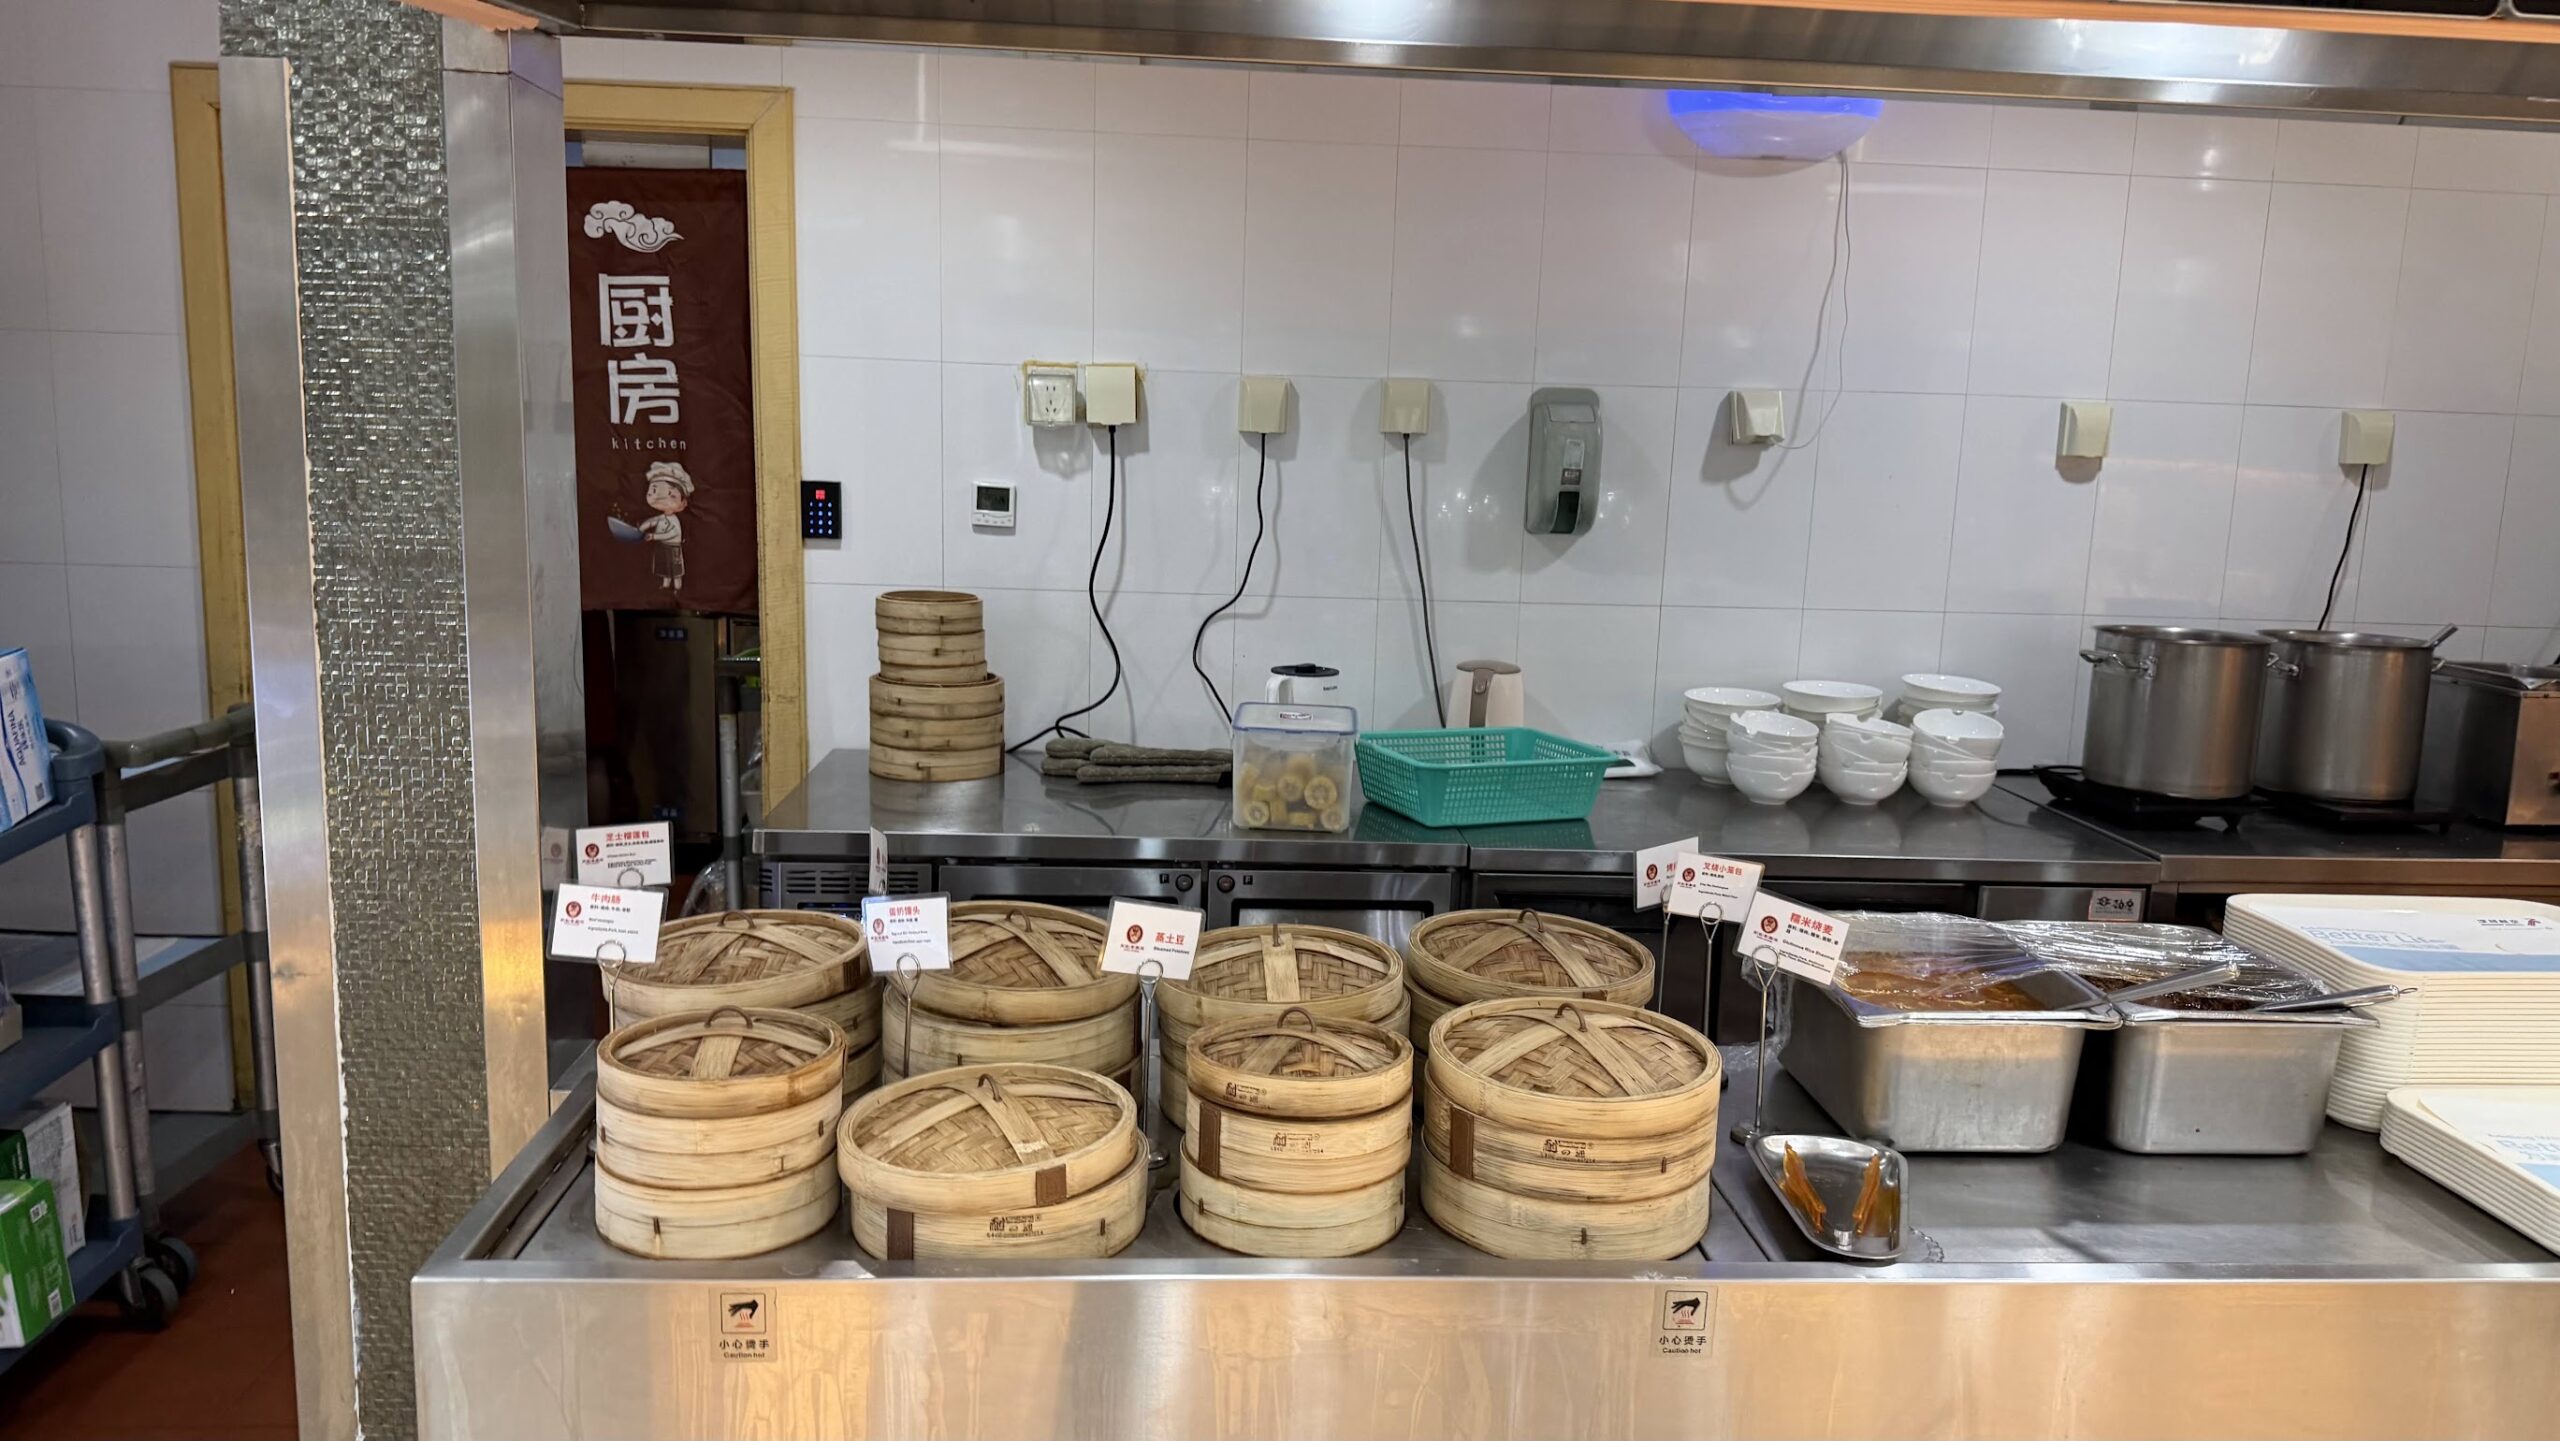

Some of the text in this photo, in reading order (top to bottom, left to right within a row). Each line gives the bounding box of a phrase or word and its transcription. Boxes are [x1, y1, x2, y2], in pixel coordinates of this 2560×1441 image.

[598, 273, 680, 425] 厨房
[611, 437, 687, 451] kitchen
[719, 1339, 770, 1350] 小心烫手
[1659, 1335, 1708, 1346] 小心烫手
